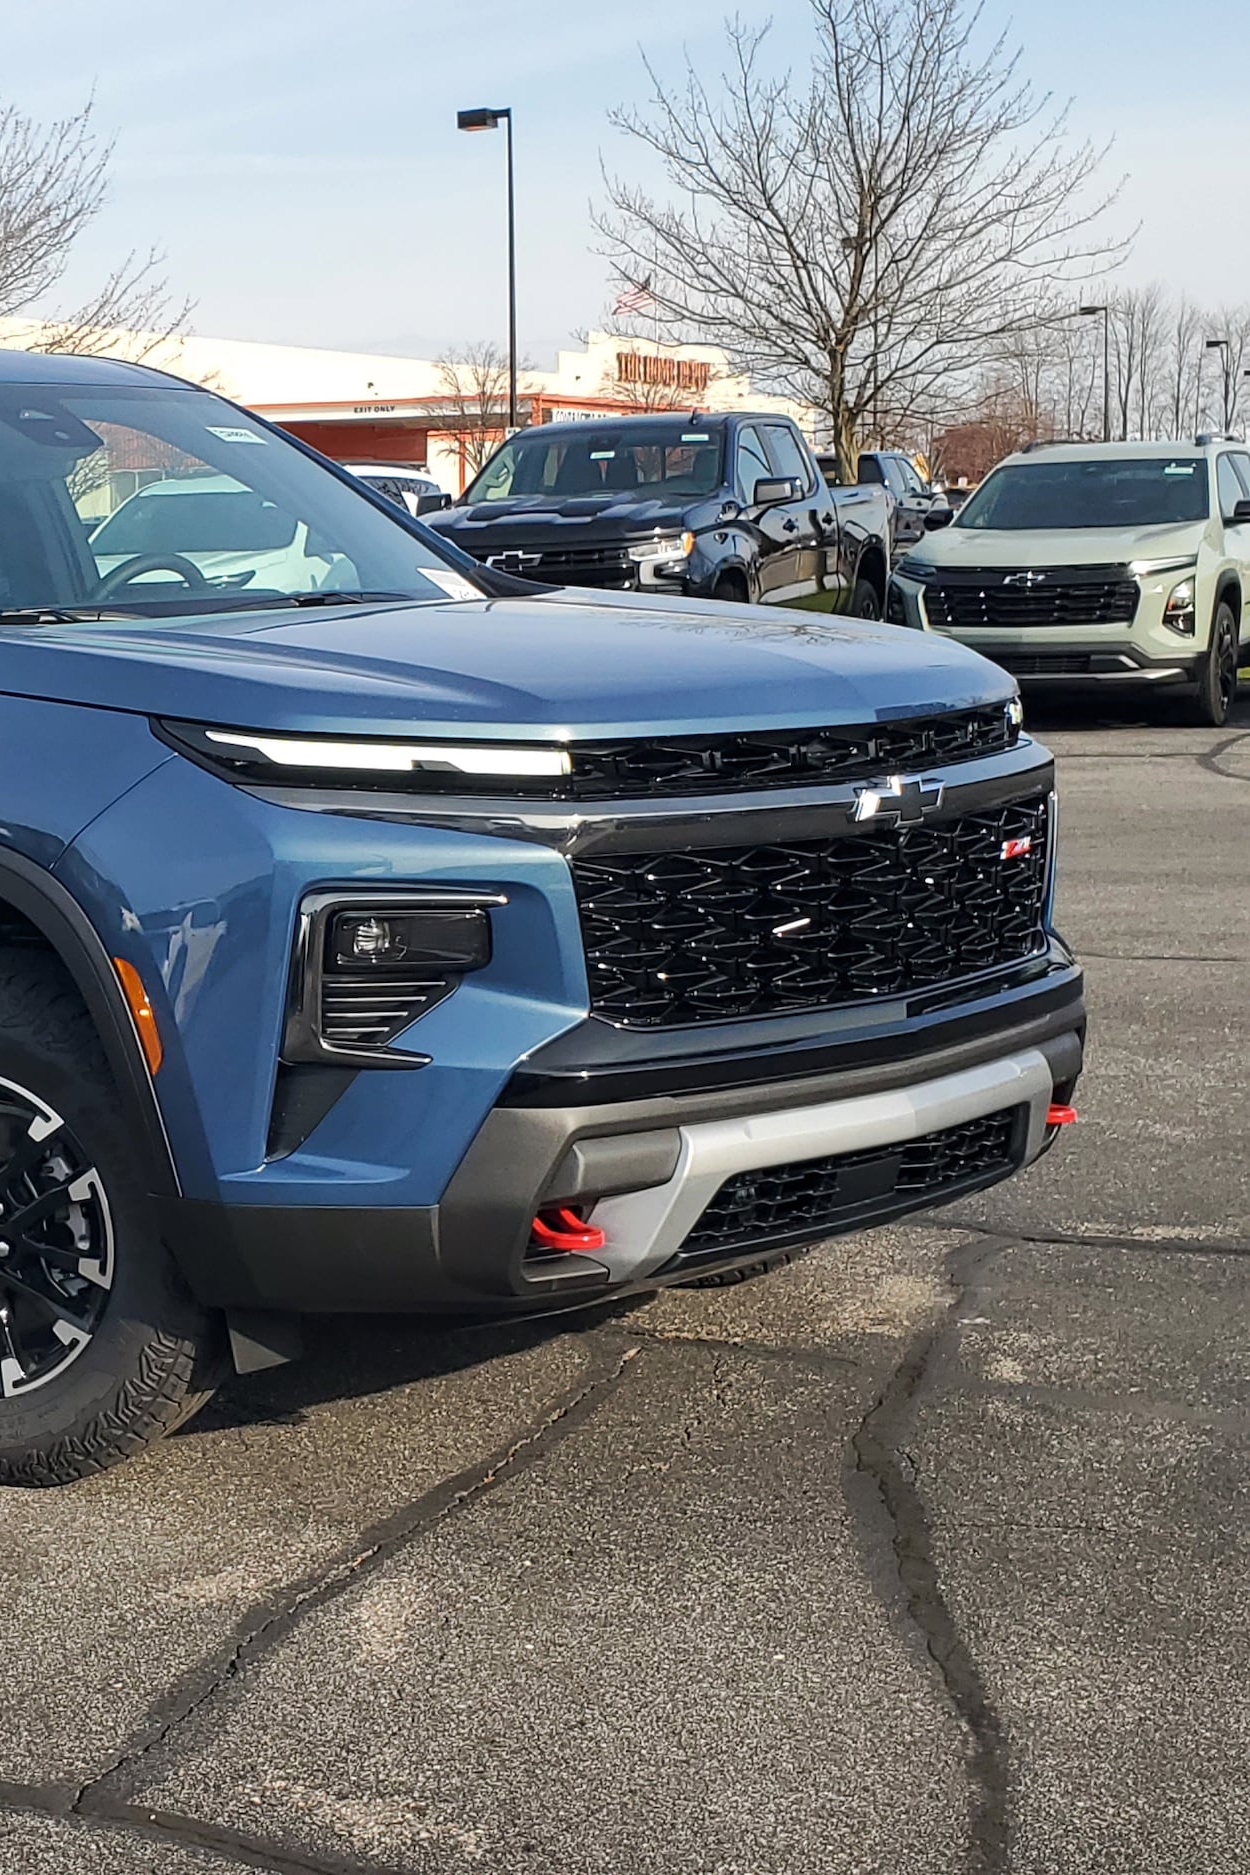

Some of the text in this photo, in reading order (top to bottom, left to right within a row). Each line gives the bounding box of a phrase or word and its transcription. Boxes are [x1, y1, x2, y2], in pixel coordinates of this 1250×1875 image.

[616, 352, 641, 382] THE
[643, 355, 675, 387] HOME
[374, 405, 395, 413] ONLY
